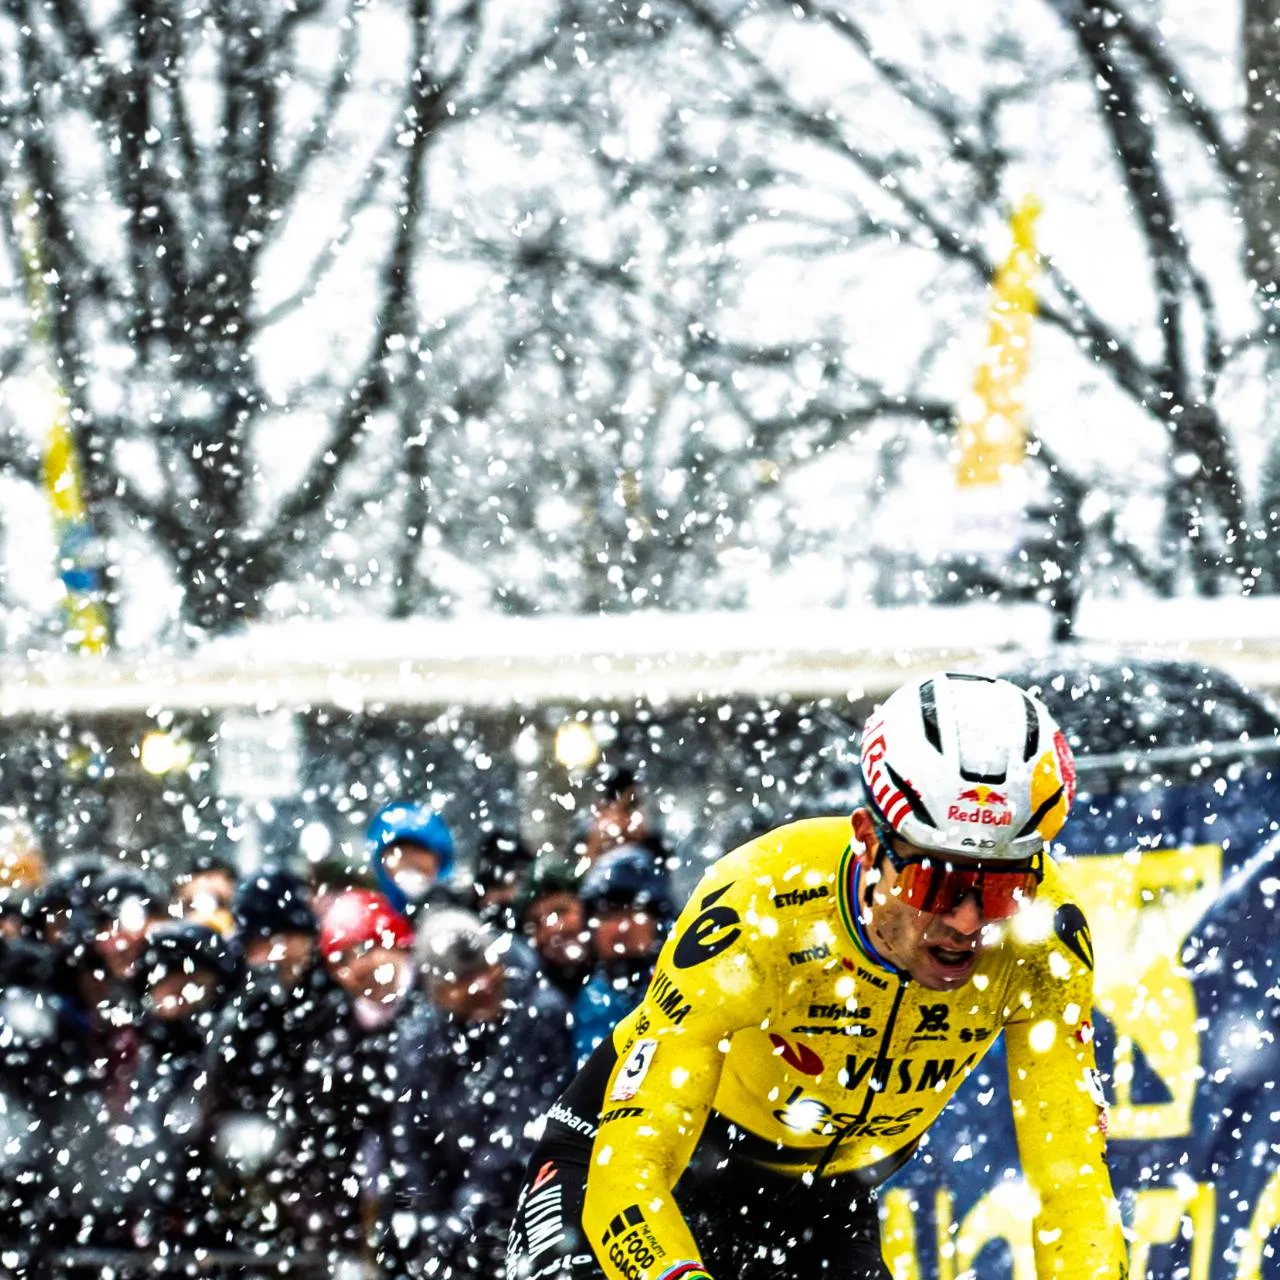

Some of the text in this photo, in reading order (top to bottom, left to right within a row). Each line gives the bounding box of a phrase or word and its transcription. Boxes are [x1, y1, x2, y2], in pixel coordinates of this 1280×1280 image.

[947, 805, 1013, 827] Red Bull
[650, 967, 693, 1026] VISMA
[625, 1041, 658, 1079] 5
[621, 1230, 655, 1270] FOOD
